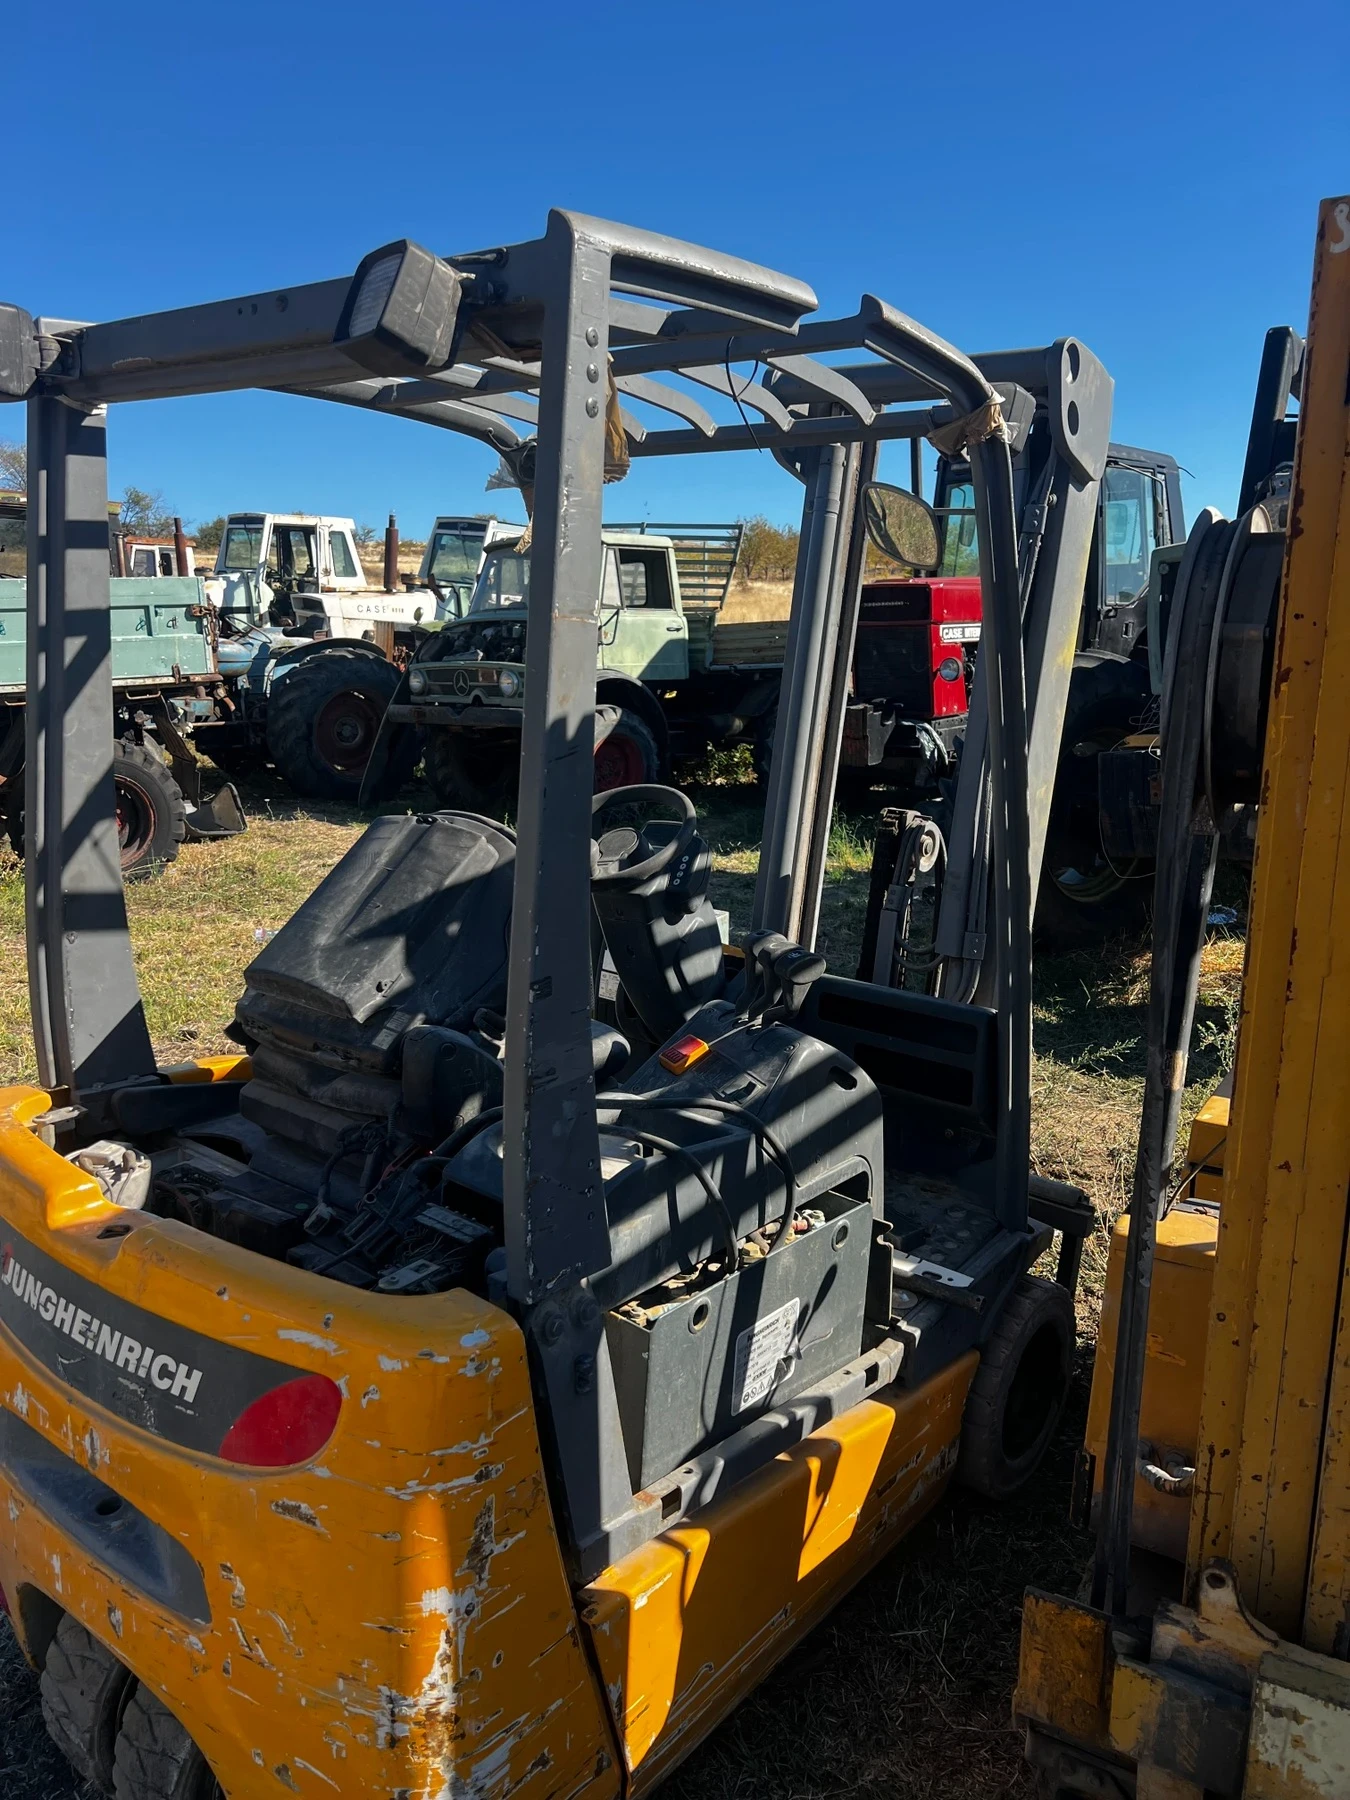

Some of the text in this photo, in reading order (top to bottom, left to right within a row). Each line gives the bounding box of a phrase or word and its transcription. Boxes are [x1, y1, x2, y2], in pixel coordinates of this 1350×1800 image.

[356, 604, 387, 614] CASE
[943, 628, 963, 640] CASE
[1, 1257, 204, 1404] JUNGHEINRICH
